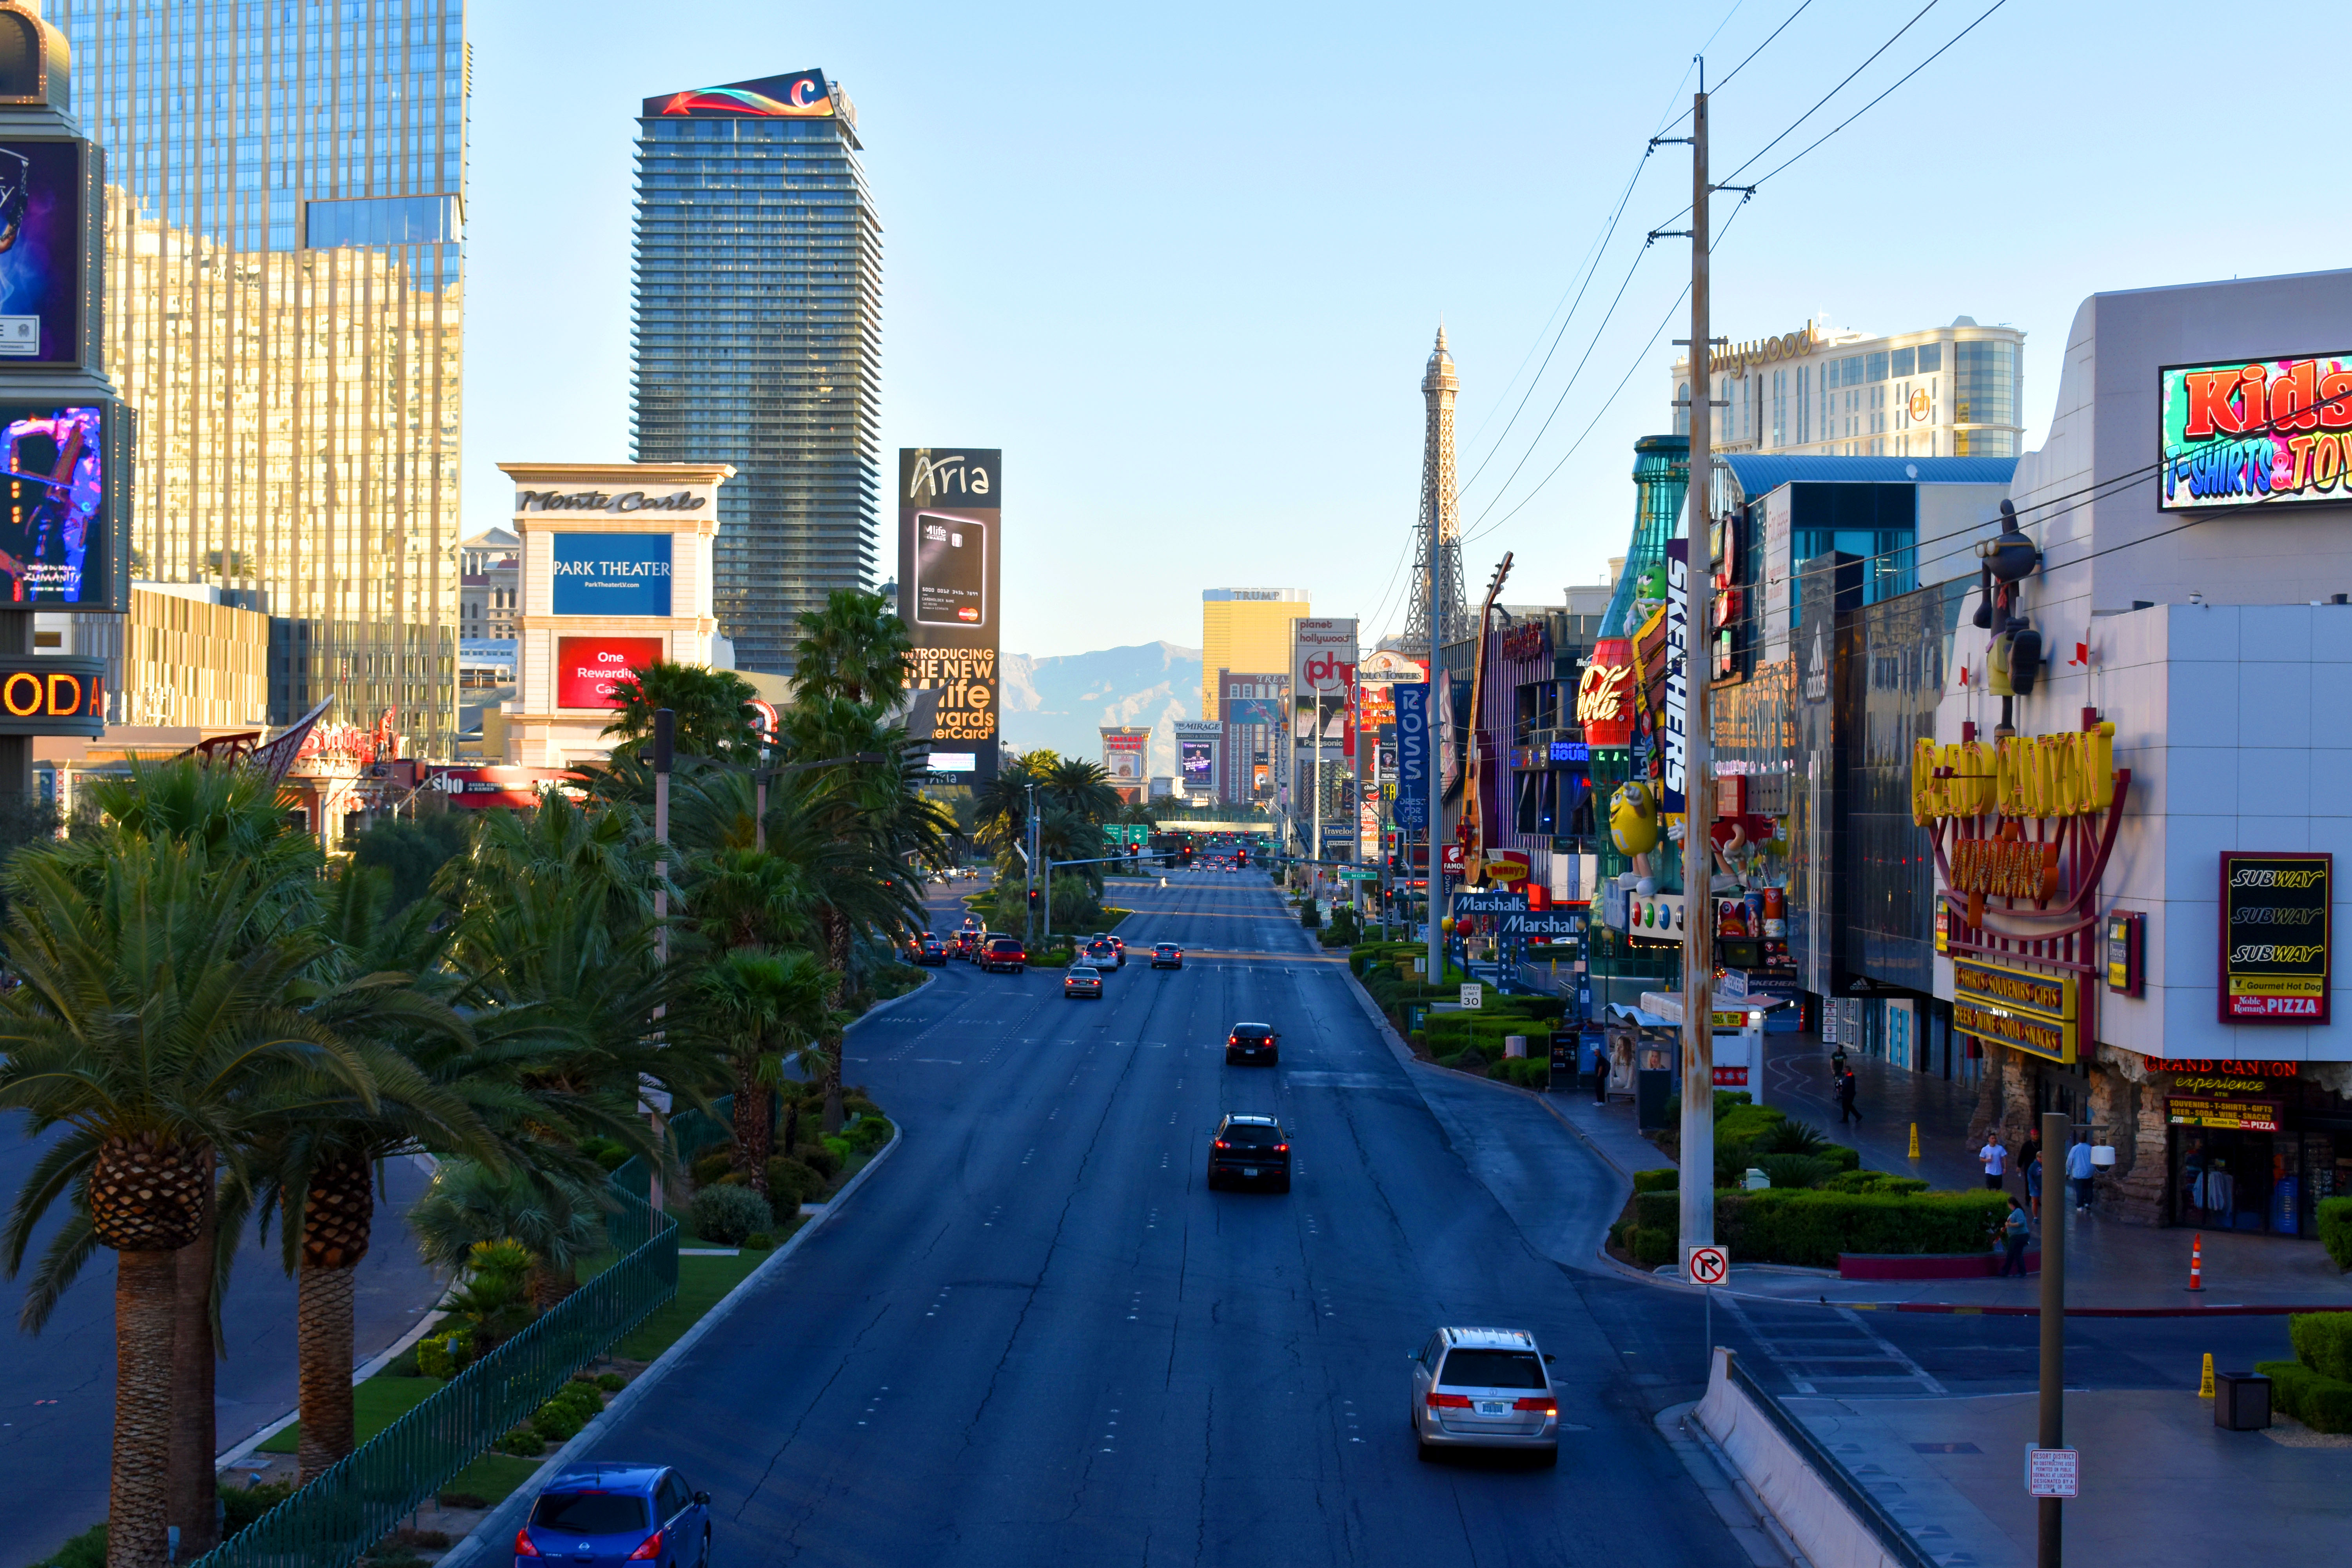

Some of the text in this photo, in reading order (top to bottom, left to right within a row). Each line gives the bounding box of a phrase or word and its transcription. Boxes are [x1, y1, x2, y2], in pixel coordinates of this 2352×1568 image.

[1710, 319, 1812, 379] llywood
[2185, 360, 2352, 436] Kids
[910, 456, 989, 498] Aria
[2165, 439, 2273, 499] T-SHIRTS
[2270, 452, 2294, 490] &
[521, 490, 706, 513] Monte Carlo
[23, 571, 83, 583] ZUMANITY
[554, 561, 671, 576] PARK THEATER
[1234, 591, 1280, 601] TRUMP
[1300, 619, 1332, 631] planet
[1300, 633, 1349, 645] hollywood
[598, 652, 624, 662] One
[577, 668, 637, 679] Rewardin
[944, 661, 993, 678] NEW
[1308, 651, 1344, 686] ph
[1666, 557, 1688, 795] SKECHERS
[1256, 675, 1289, 684] TREA
[1806, 674, 1826, 699] adidas
[1179, 723, 1220, 731] MIRAGE
[1550, 749, 1589, 761] HOUR!
[1912, 722, 2115, 828] GRAND CANYON
[1491, 865, 1526, 877] Denny's
[2230, 869, 2325, 887] SUBWAY
[1456, 896, 1526, 911] Marshalls
[1503, 915, 1586, 933] Marshall
[2230, 907, 2324, 924] SUBWAY
[2230, 945, 2323, 963] SUBWAY
[1989, 975, 2034, 1002] SOUVENIRS
[2034, 985, 2061, 1007] GIFTS
[2247, 982, 2284, 990] Gourmet
[2304, 983, 2321, 992] Dog
[2234, 1004, 2266, 1014] Roman's
[2239, 996, 2316, 1013] Noble PIZZA
[1955, 1005, 1975, 1026] BEER
[2000, 1018, 2024, 1040] SODA
[2024, 1024, 2061, 1051] SNACKS
[2144, 1054, 2297, 1076] GRAND CANYON
[2176, 1076, 2265, 1093] experience
[2169, 1100, 2273, 1113] SOUVENIRS T-SHIRTS GIFTS
[2171, 1116, 2198, 1124] SUBWAY
[2251, 1121, 2276, 1130] PIZZA
[2242, 1113, 2271, 1121] SNACKS
